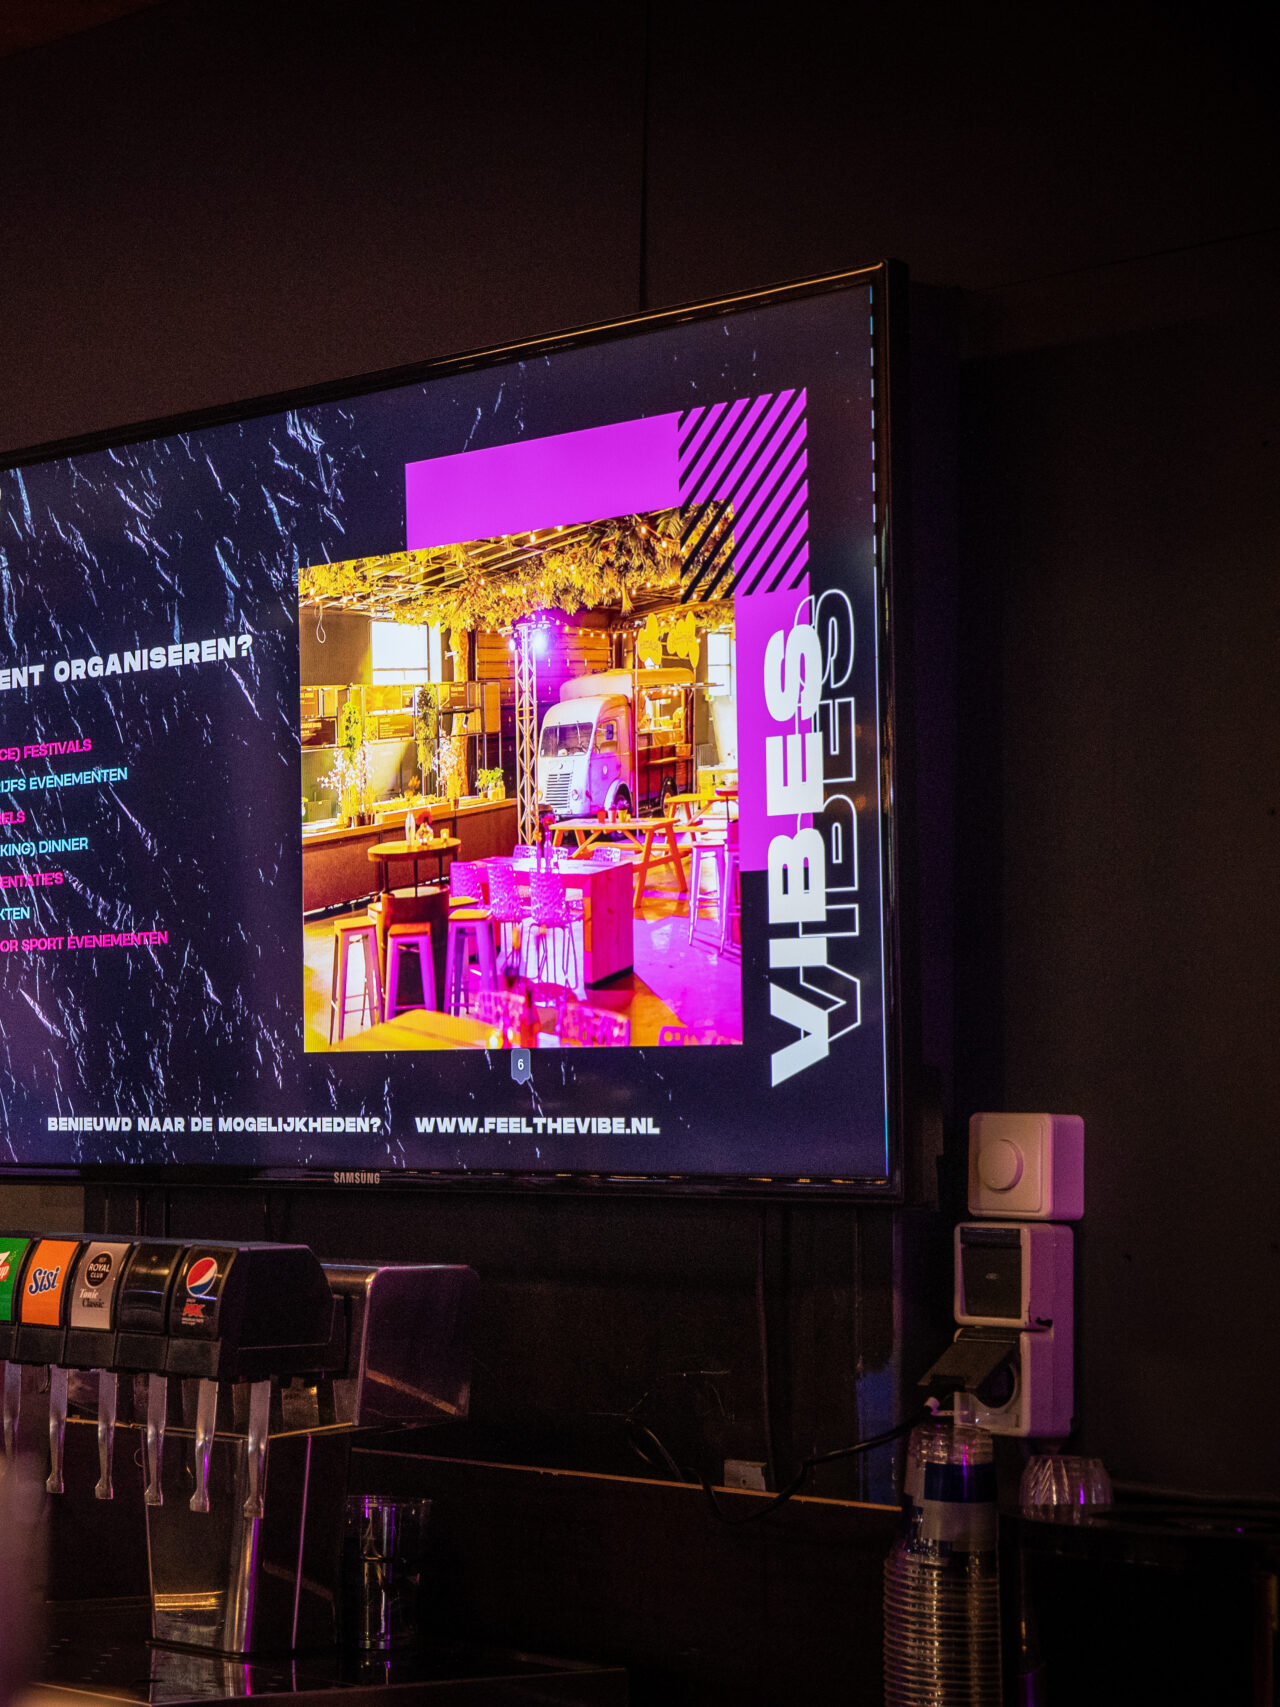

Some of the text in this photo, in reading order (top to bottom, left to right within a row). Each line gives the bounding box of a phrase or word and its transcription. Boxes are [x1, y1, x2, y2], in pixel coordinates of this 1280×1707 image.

[54, 634, 253, 682] ORGANISEREN?
[23, 738, 92, 758] FESTIVALS
[29, 767, 128, 791] EVENEMENTEN
[39, 837, 89, 854] DINNER
[764, 623, 829, 1088] VIBES
[21, 937, 64, 952] SPORT
[67, 931, 168, 950] EVENEMENTEN
[517, 1059, 524, 1070] 6
[47, 1117, 381, 1133] BENIEUWD NAAR DE MOGELIJKHEDEN?
[415, 1117, 660, 1134] WWW.FEELTHEVIBE.NL
[333, 1171, 380, 1185] SAMSUNG
[88, 1263, 110, 1273] ROYAL
[28, 1265, 61, 1295] Sisi
[80, 1288, 99, 1299] Tonic
[82, 1298, 105, 1308] Classic
